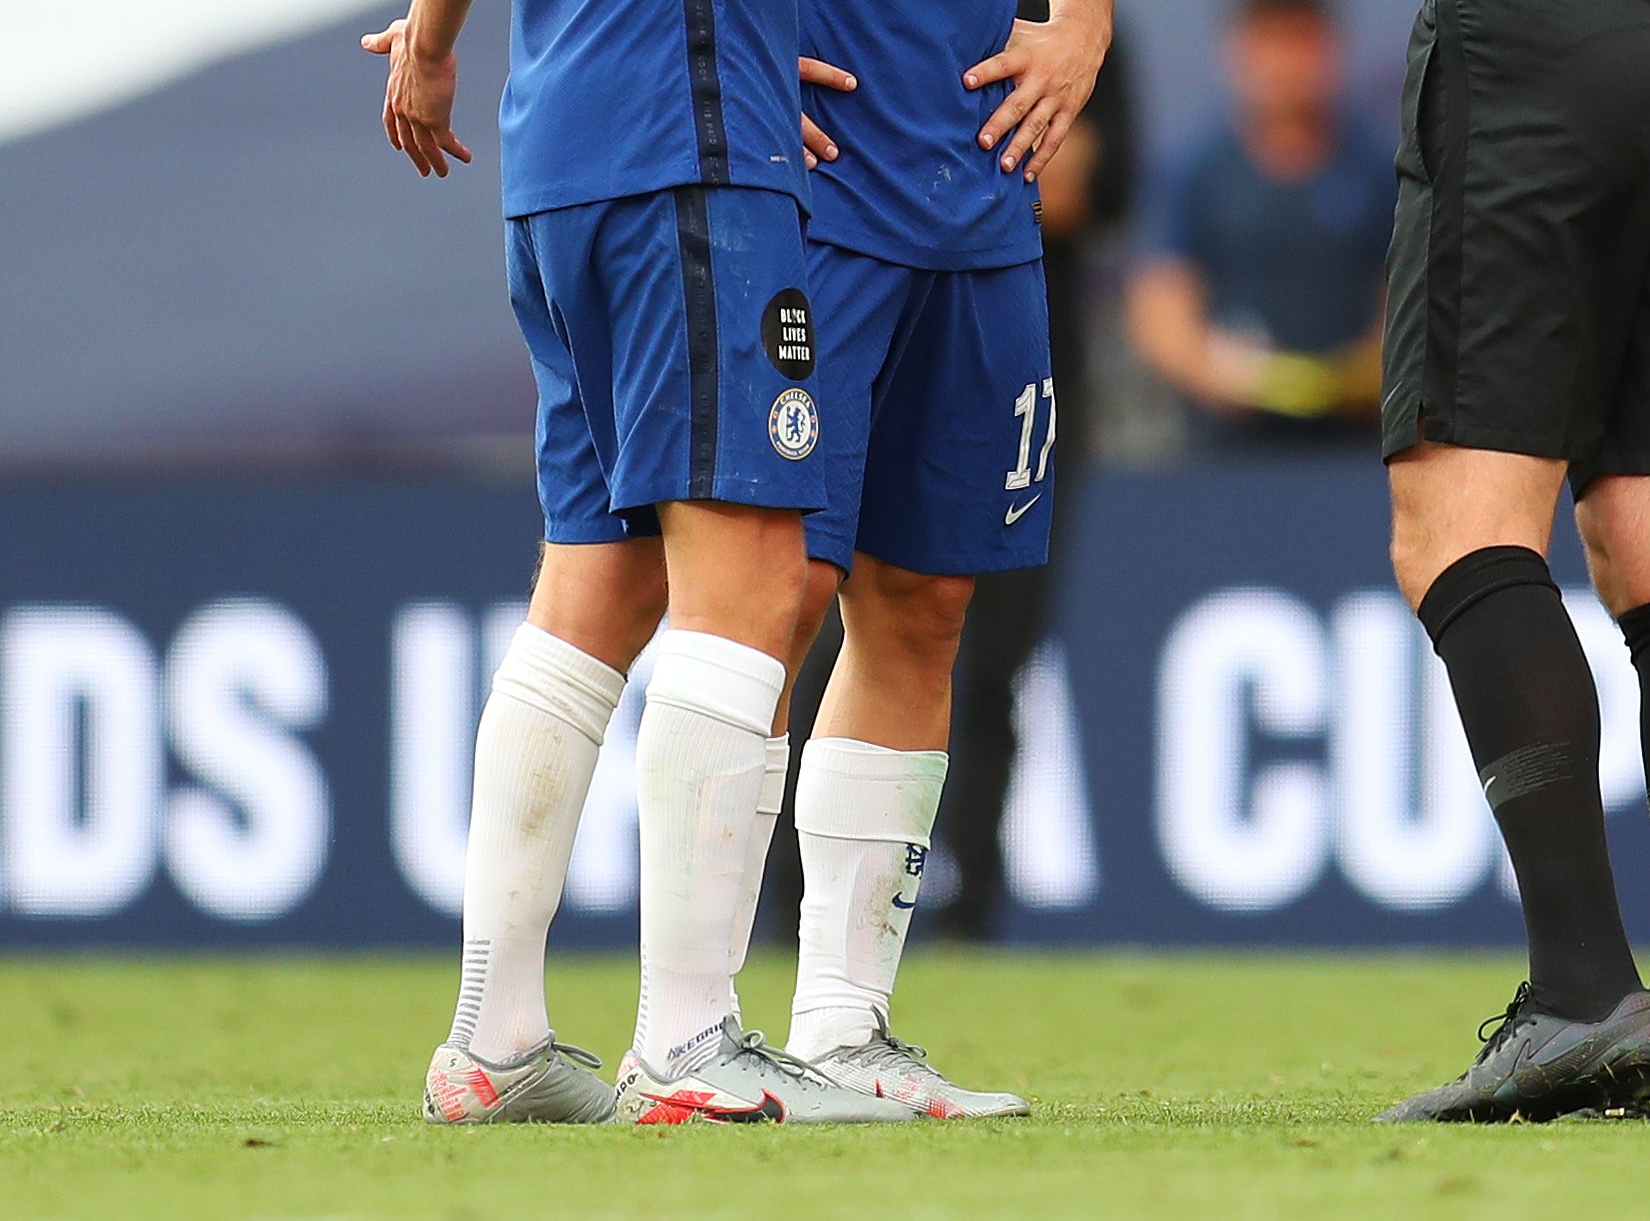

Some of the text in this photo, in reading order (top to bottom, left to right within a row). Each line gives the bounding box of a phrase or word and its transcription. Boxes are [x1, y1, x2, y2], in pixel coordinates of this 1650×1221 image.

[783, 327, 807, 343] LIVES
[778, 345, 811, 361] MATTER
[780, 391, 811, 409] CHELSEA
